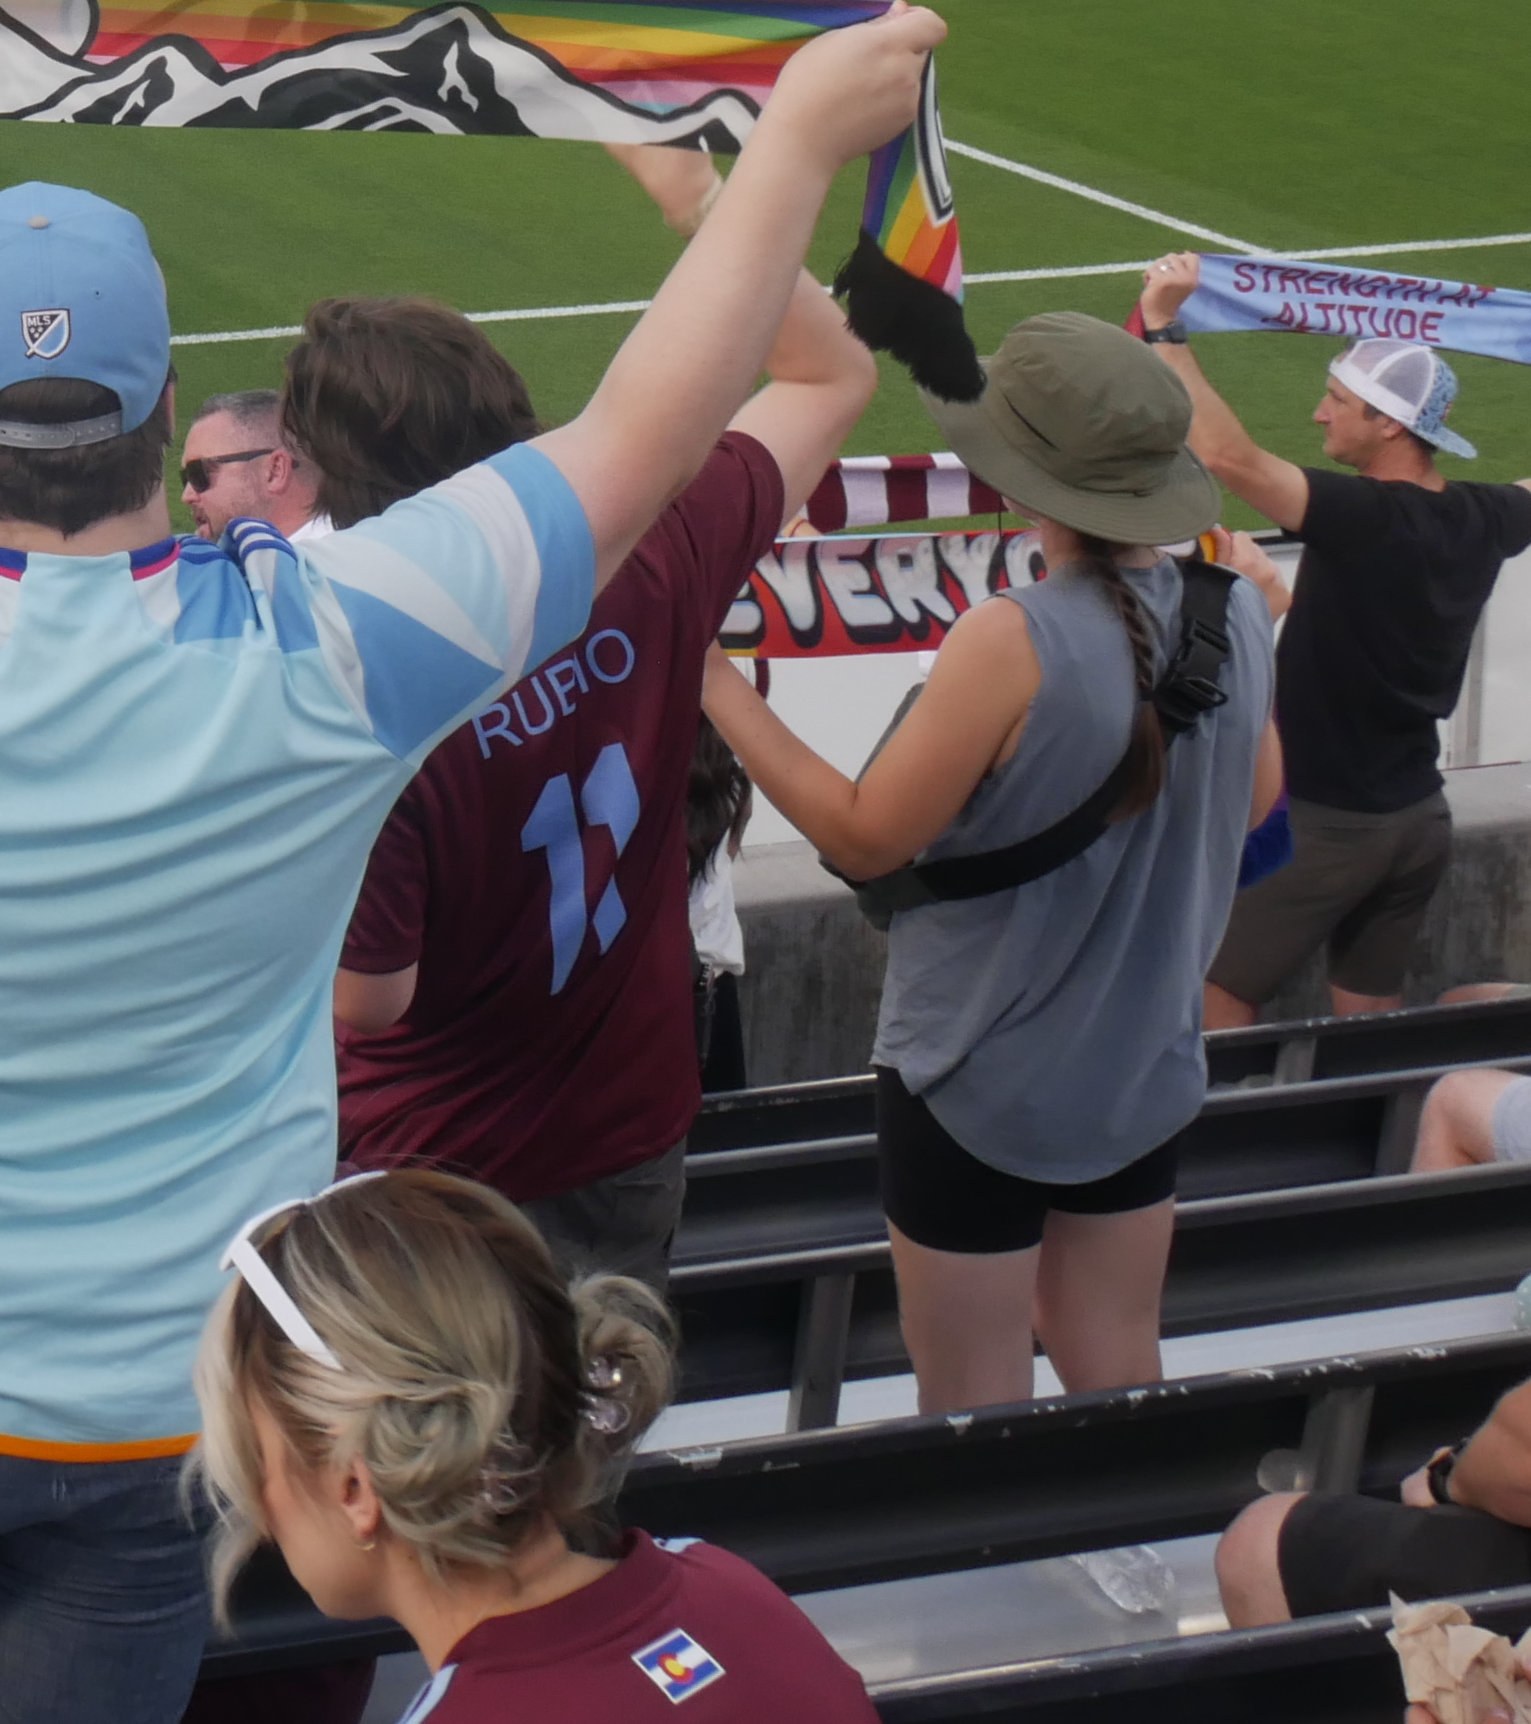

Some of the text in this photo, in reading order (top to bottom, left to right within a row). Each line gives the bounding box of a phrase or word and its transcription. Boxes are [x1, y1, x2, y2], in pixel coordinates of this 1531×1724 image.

[1233, 262, 1432, 303] STRENGTH
[27, 315, 51, 327] MLS
[1261, 301, 1445, 343] ALTITUDE
